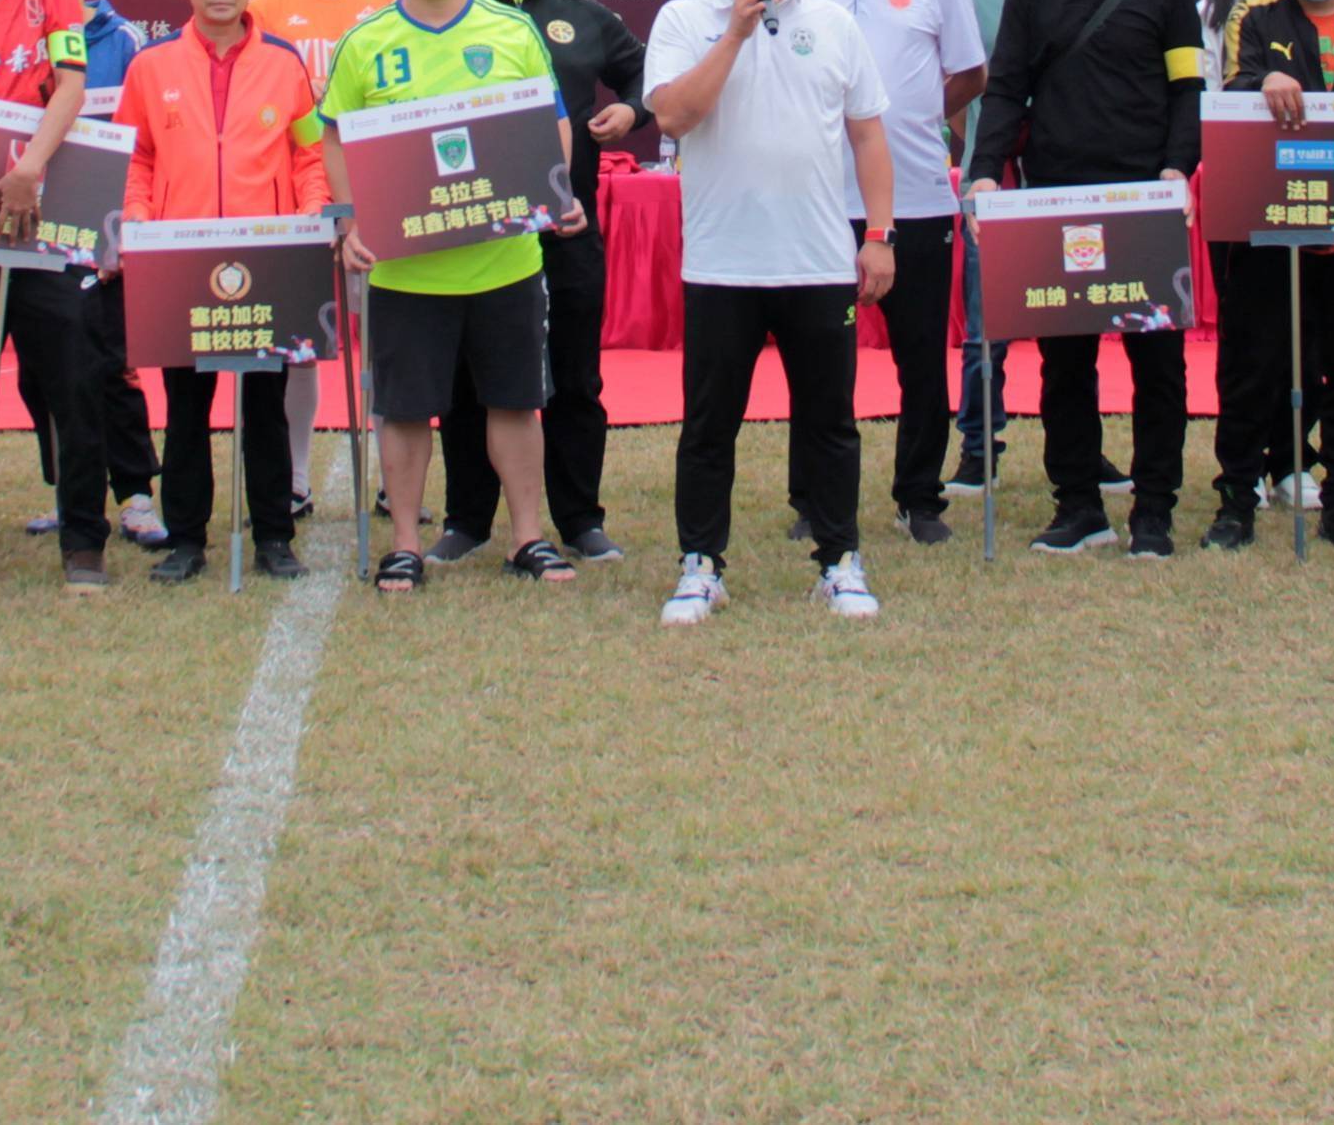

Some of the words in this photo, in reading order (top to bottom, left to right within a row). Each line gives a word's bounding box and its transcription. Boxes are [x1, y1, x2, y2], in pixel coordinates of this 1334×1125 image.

[375, 47, 412, 89] 13
[429, 177, 494, 208] 乌拉圭
[1286, 180, 1329, 201] 法国
[189, 303, 273, 328] 塞内加尔
[191, 328, 274, 353] 建校校友
